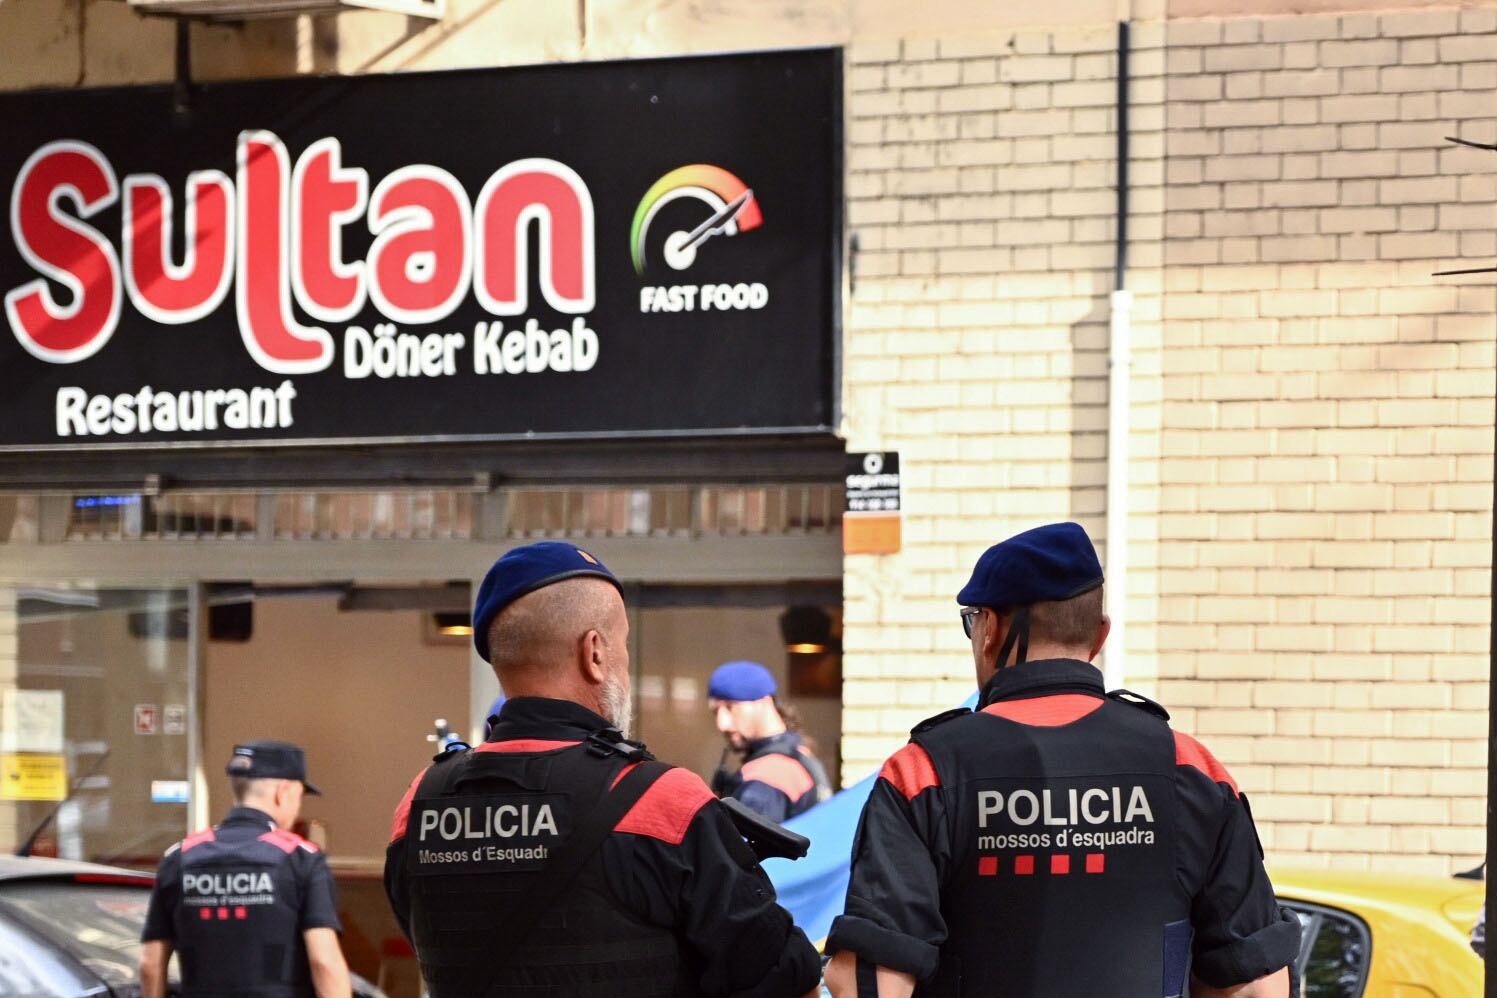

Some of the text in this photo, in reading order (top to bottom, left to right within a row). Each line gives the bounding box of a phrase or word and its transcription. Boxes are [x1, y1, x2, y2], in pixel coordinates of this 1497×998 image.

[6, 129, 596, 374] Sultan
[639, 283, 769, 313] FAST FOOD
[343, 317, 600, 379] Döner Kebab
[56, 380, 297, 437] Restaurant
[419, 803, 559, 842] POLICIA
[977, 785, 1155, 829] POLICIA
[419, 849, 469, 864] Mossos
[978, 832, 1051, 850] mossos
[182, 871, 274, 895] POLICIA
